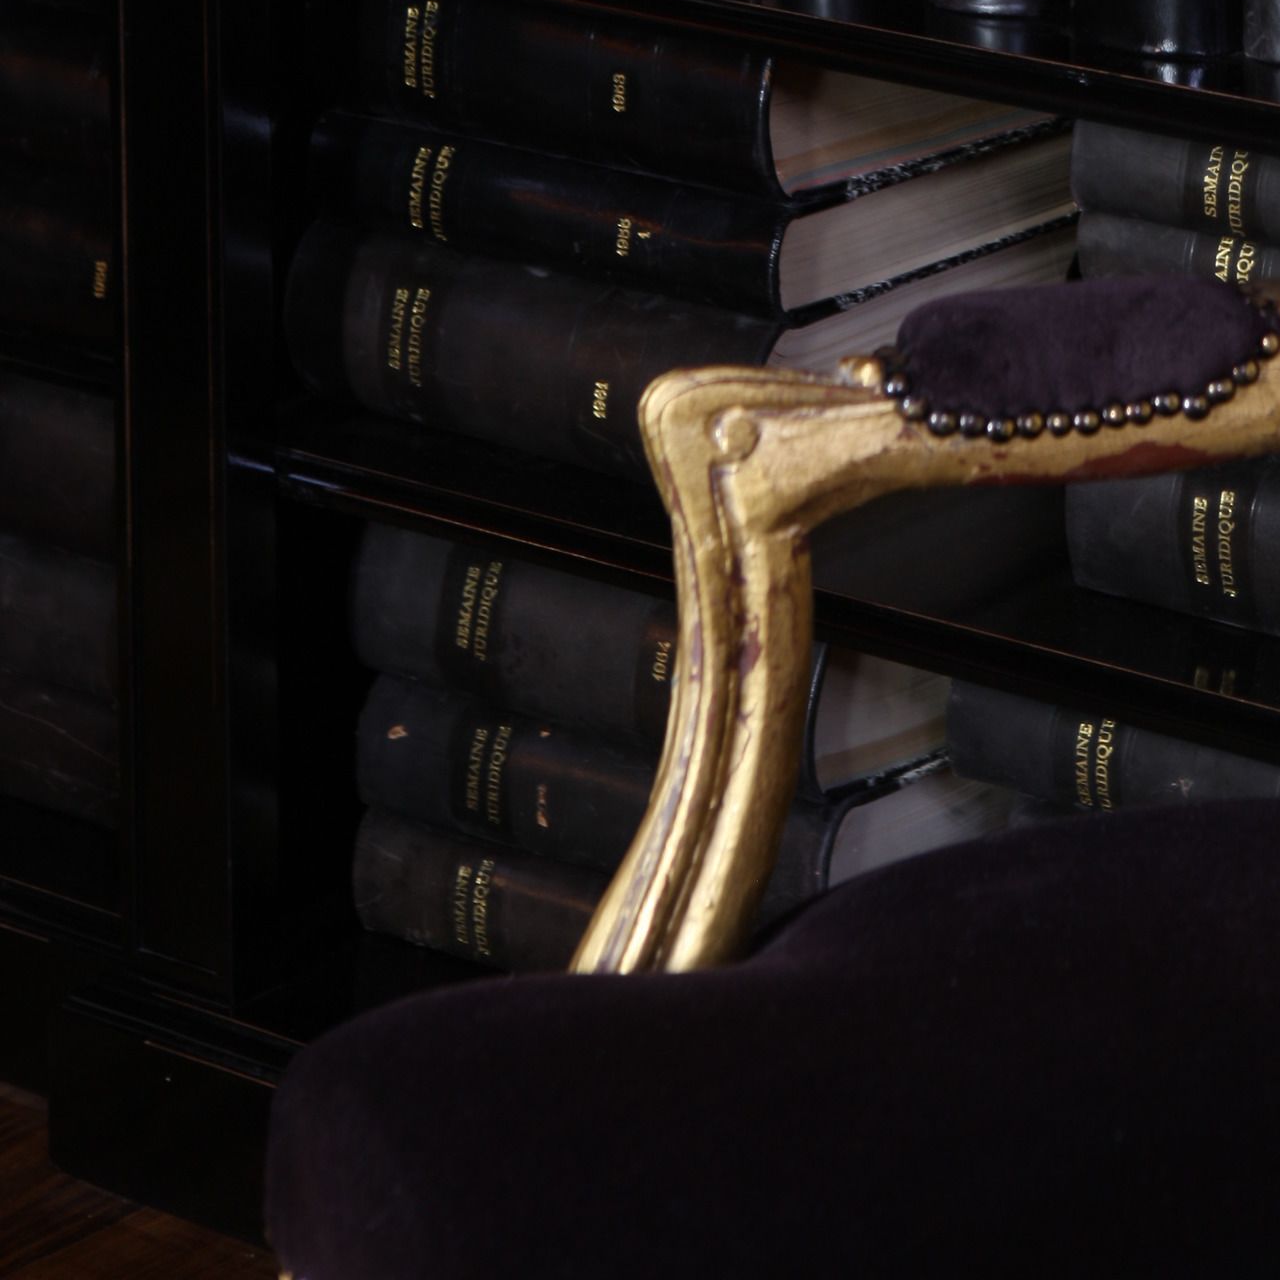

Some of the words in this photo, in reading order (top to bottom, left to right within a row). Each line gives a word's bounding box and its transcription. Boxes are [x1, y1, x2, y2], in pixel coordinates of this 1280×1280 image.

[403, 6, 421, 89] SEMAINE
[421, 0, 440, 100] JURIDIQUE
[408, 145, 433, 230] SEMAINE
[429, 144, 457, 242] JURIDIQUE
[636, 229, 653, 240] 1
[387, 287, 410, 371] SEMAINE
[408, 287, 432, 388] JURIDIQUE
[1192, 495, 1210, 586] SEMAINE
[1218, 489, 1237, 600] JURIDIQUE
[456, 565, 481, 650] SEMAINE
[473, 560, 504, 662] JURIDIQUE
[466, 727, 489, 811] SEMAINE
[486, 724, 513, 825] JURIDIQUE
[1075, 721, 1095, 807] SEMAINE
[454, 865, 473, 945] SEMAINE
[473, 858, 496, 957] JURIDIQUE
